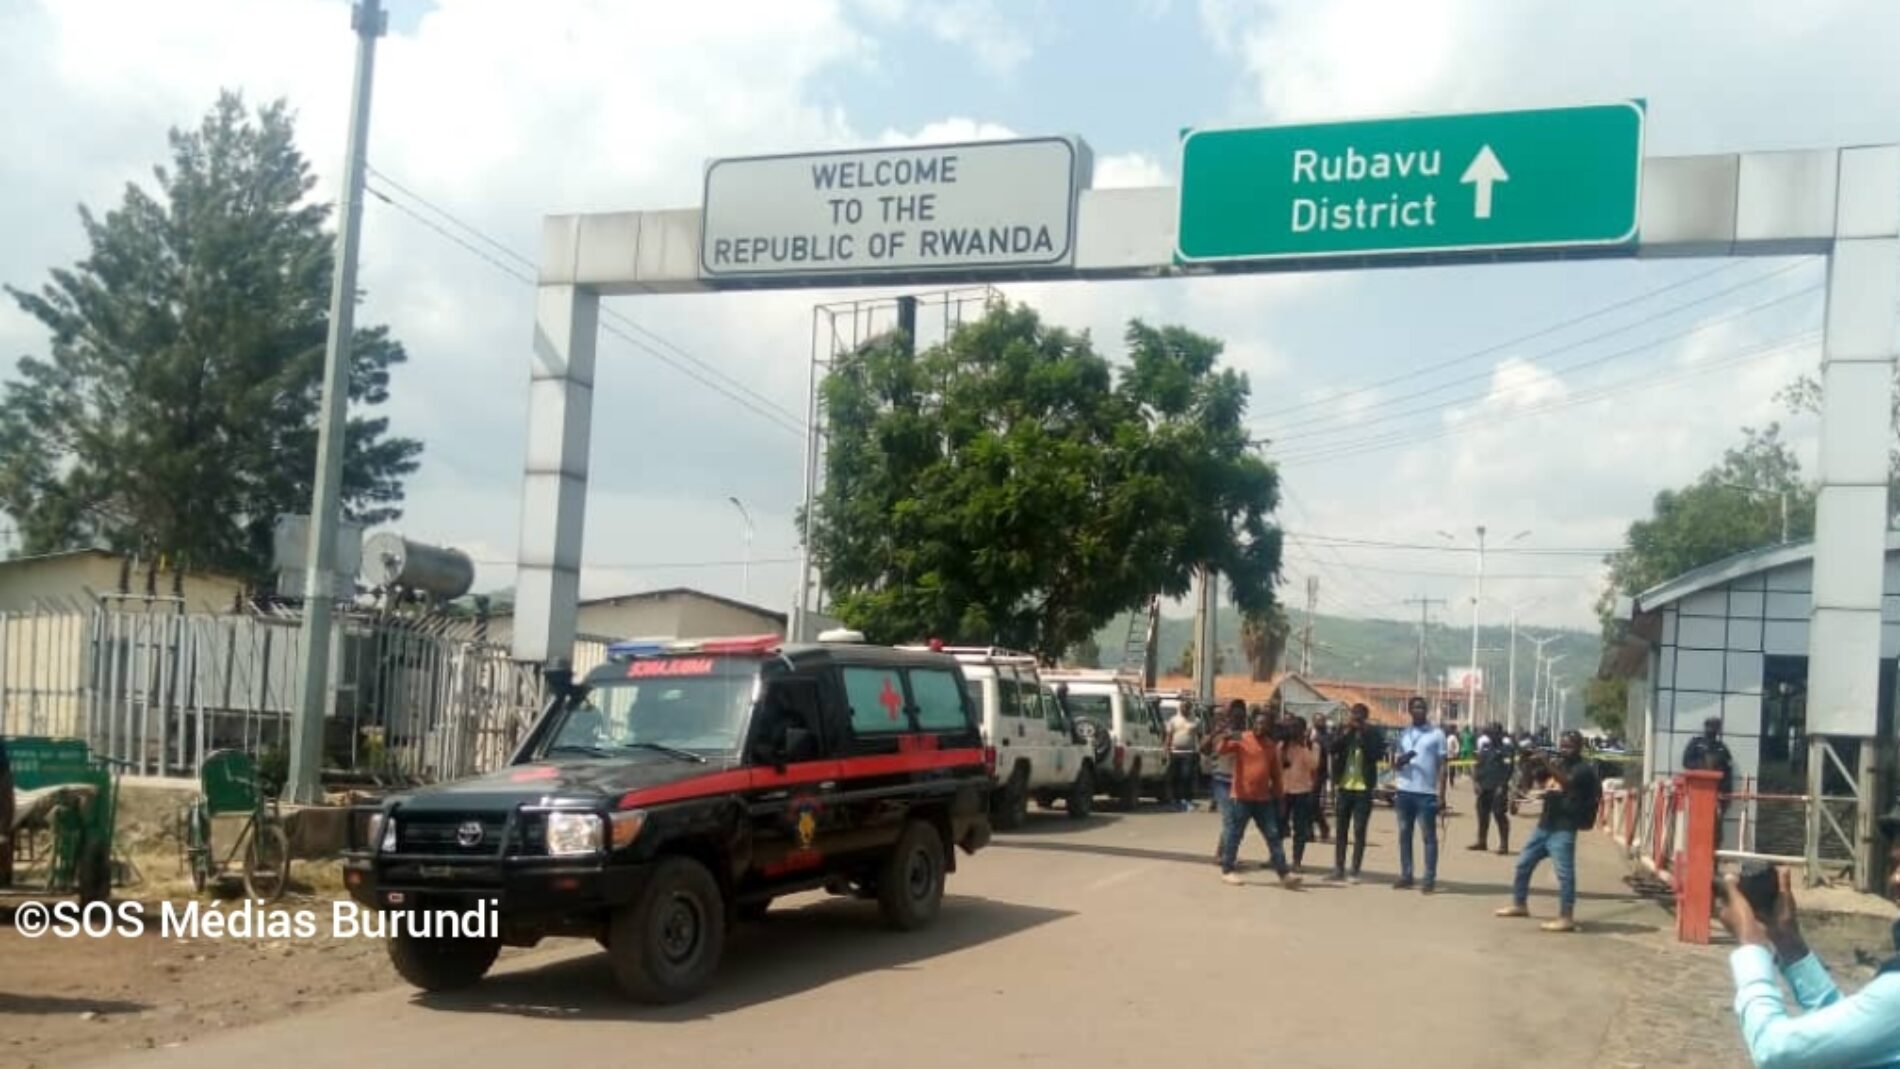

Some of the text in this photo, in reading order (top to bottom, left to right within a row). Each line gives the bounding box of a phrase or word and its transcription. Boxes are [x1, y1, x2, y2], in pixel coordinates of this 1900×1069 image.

[812, 156, 958, 190] WELCOME
[1292, 146, 1441, 183] Rubavu
[829, 194, 937, 225] TO THE
[1291, 194, 1437, 232] District
[714, 224, 1054, 264] REPUBLIC OF RWANDA
